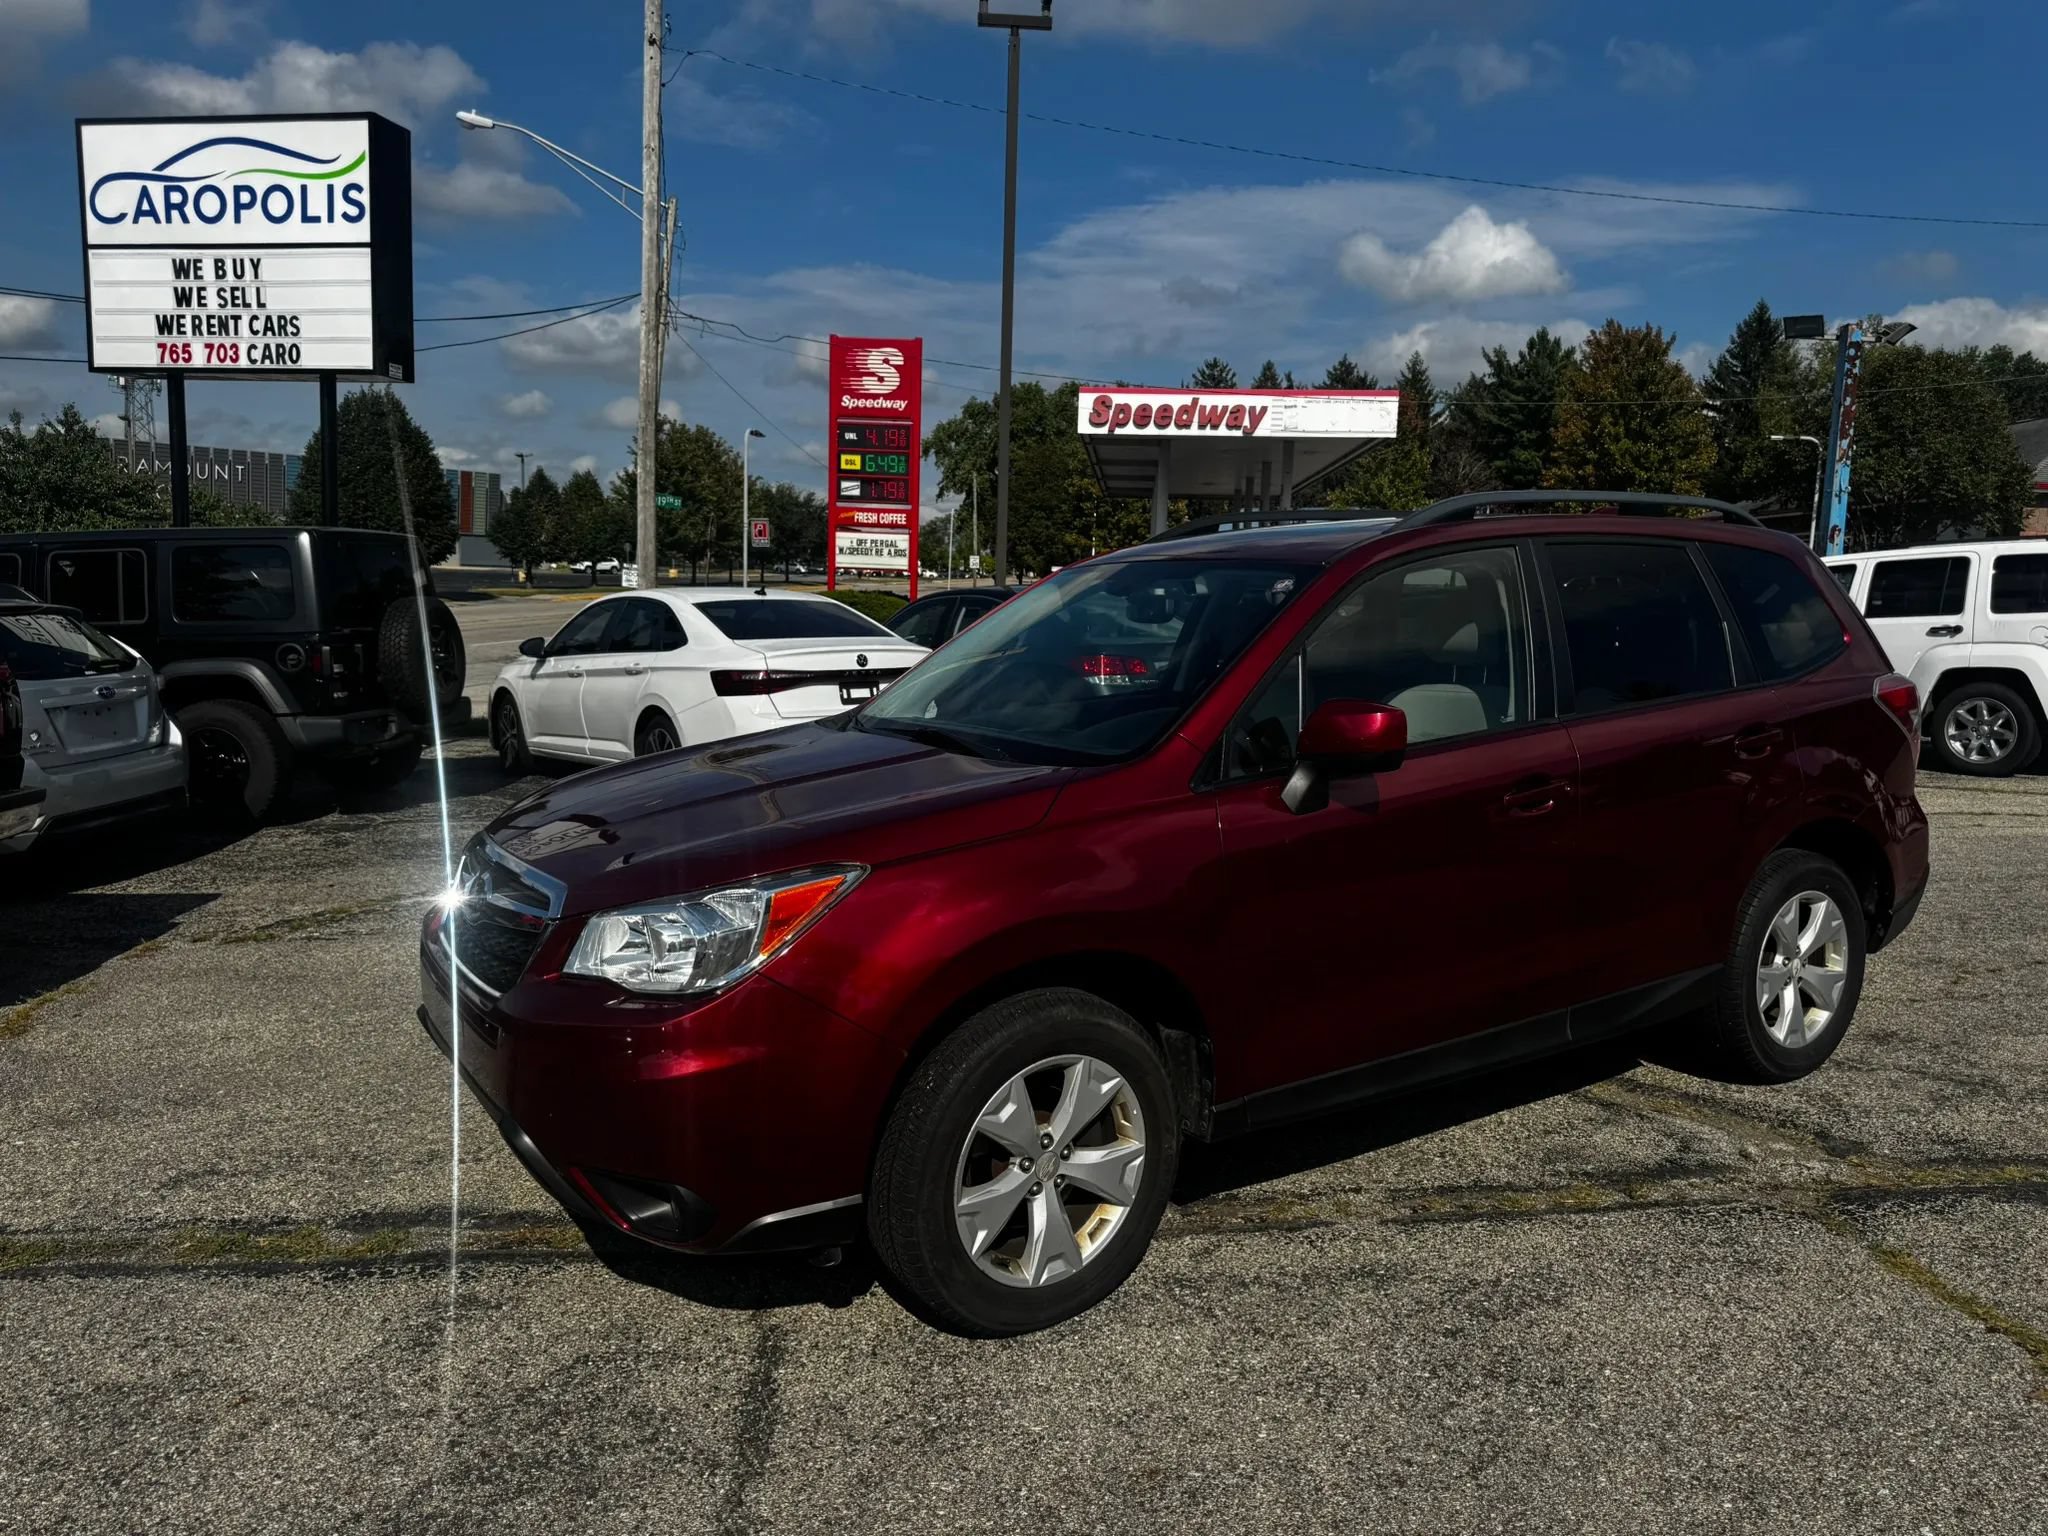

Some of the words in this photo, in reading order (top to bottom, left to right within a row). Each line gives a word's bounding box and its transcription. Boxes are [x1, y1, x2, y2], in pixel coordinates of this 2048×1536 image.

[89, 174, 366, 225] CAROPOLIS
[171, 257, 204, 280] WE
[213, 257, 262, 280] BUY
[173, 286, 208, 308] WE
[216, 286, 267, 308] SELL
[155, 314, 187, 336] WE
[191, 314, 242, 337] RENT
[248, 314, 301, 337] CARS
[156, 343, 193, 364] 765
[203, 343, 240, 364] 703
[247, 342, 301, 365] CARO
[840, 394, 908, 411] Speedway
[1088, 394, 1269, 436] Speedway
[844, 432, 859, 440] UNL
[844, 458, 857, 466] DSL
[865, 454, 898, 473] 6.49
[854, 511, 878, 524] FRESH
[879, 512, 907, 525] COFFEE
[856, 538, 868, 547] OFF
